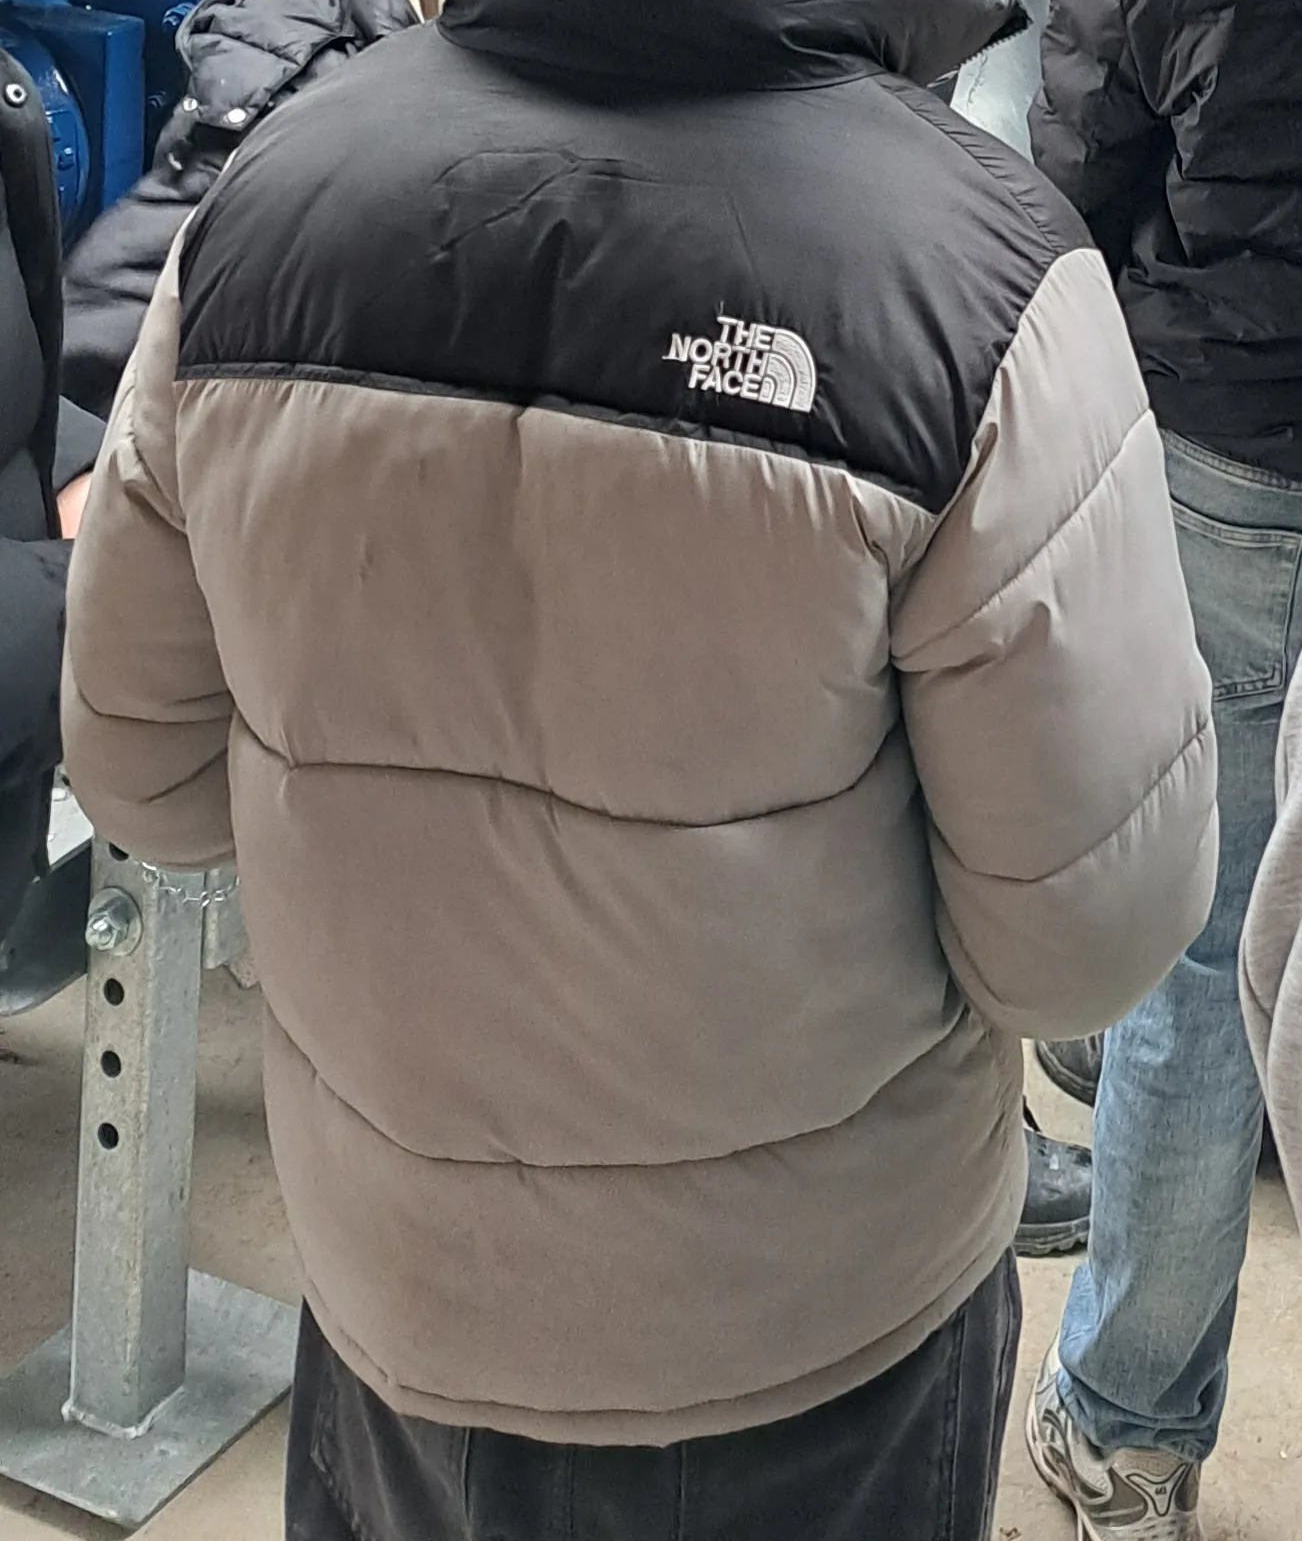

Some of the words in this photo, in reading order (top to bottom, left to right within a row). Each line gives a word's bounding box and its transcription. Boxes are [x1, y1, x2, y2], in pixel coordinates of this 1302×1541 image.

[717, 316, 776, 350] THE
[667, 333, 768, 377] NORTH
[688, 363, 762, 401] FACE
